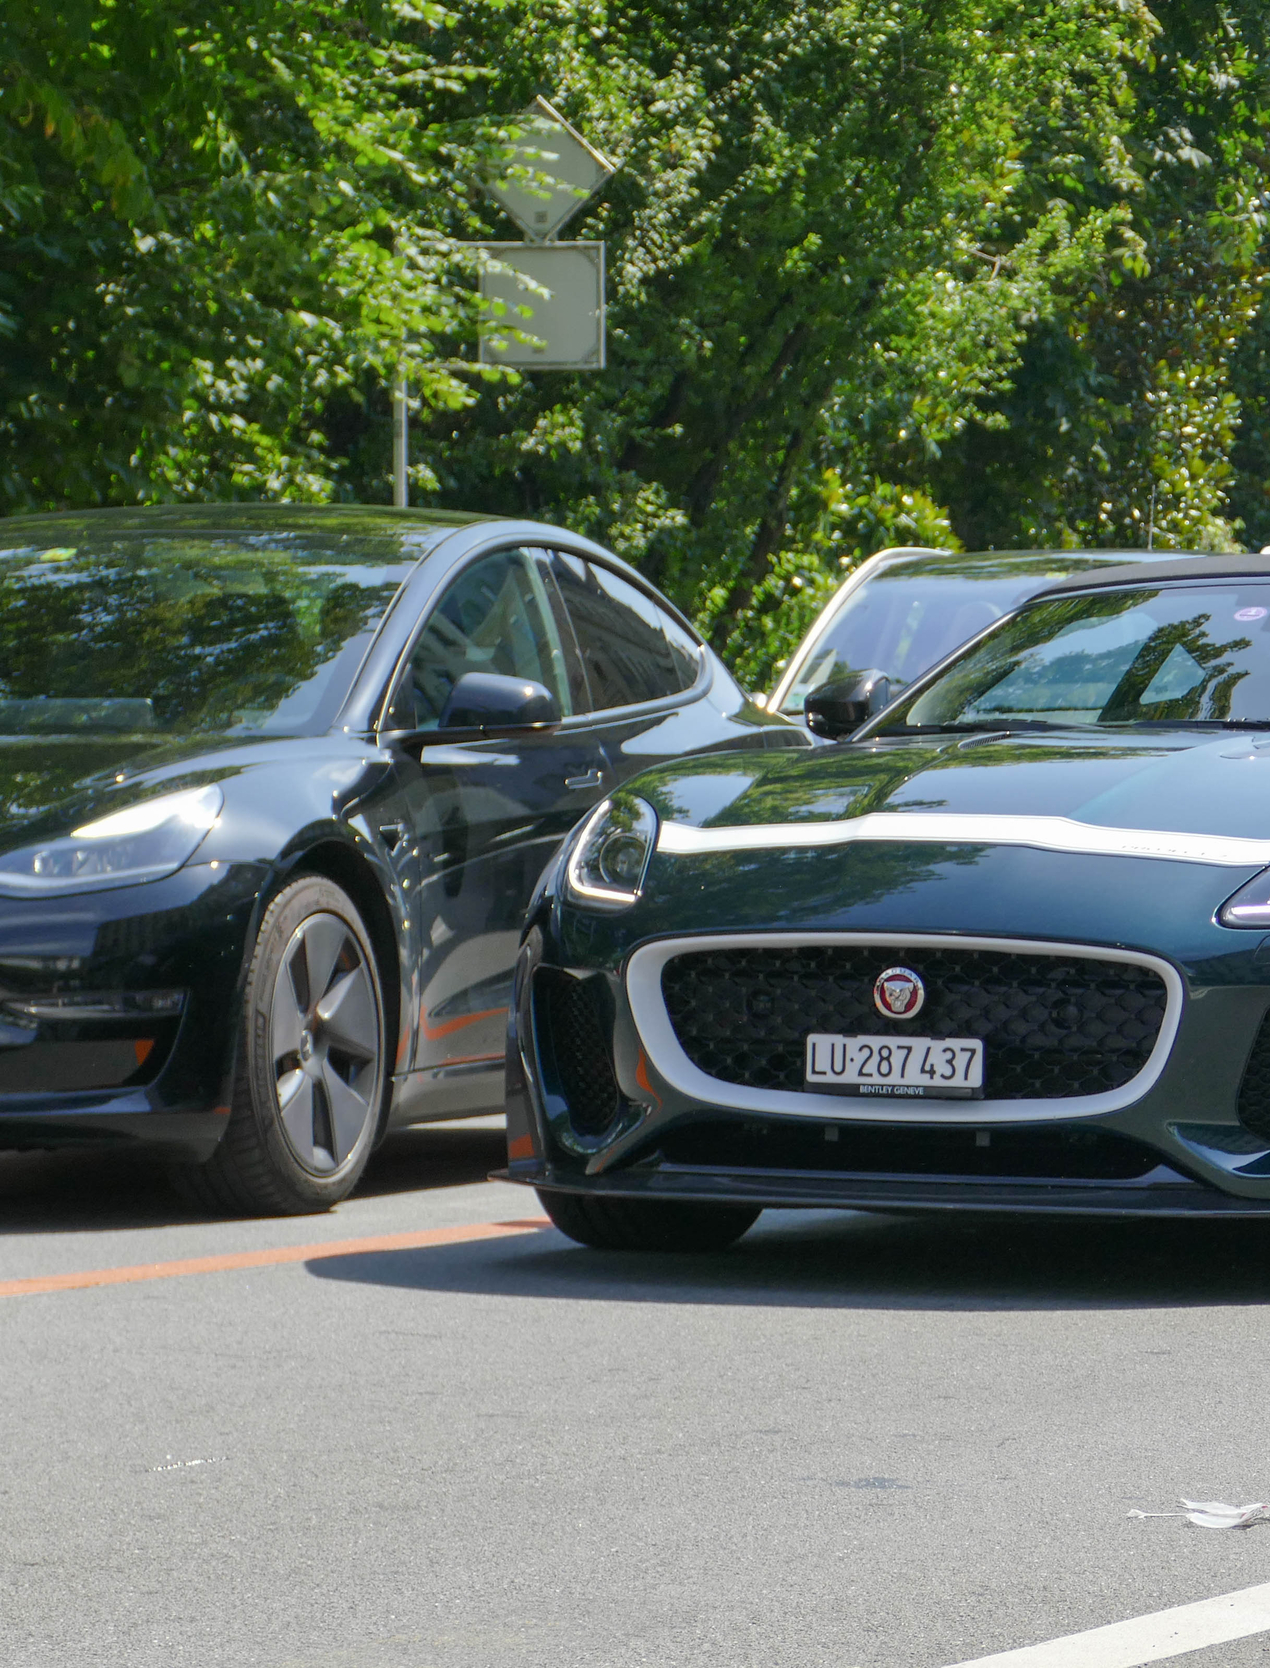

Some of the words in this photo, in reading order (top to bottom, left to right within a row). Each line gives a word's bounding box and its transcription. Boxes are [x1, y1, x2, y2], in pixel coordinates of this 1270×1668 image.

[919, 1046, 978, 1082] 437
[859, 1084, 892, 1095] BENTLEY
[894, 1085, 925, 1096] GENEVE
